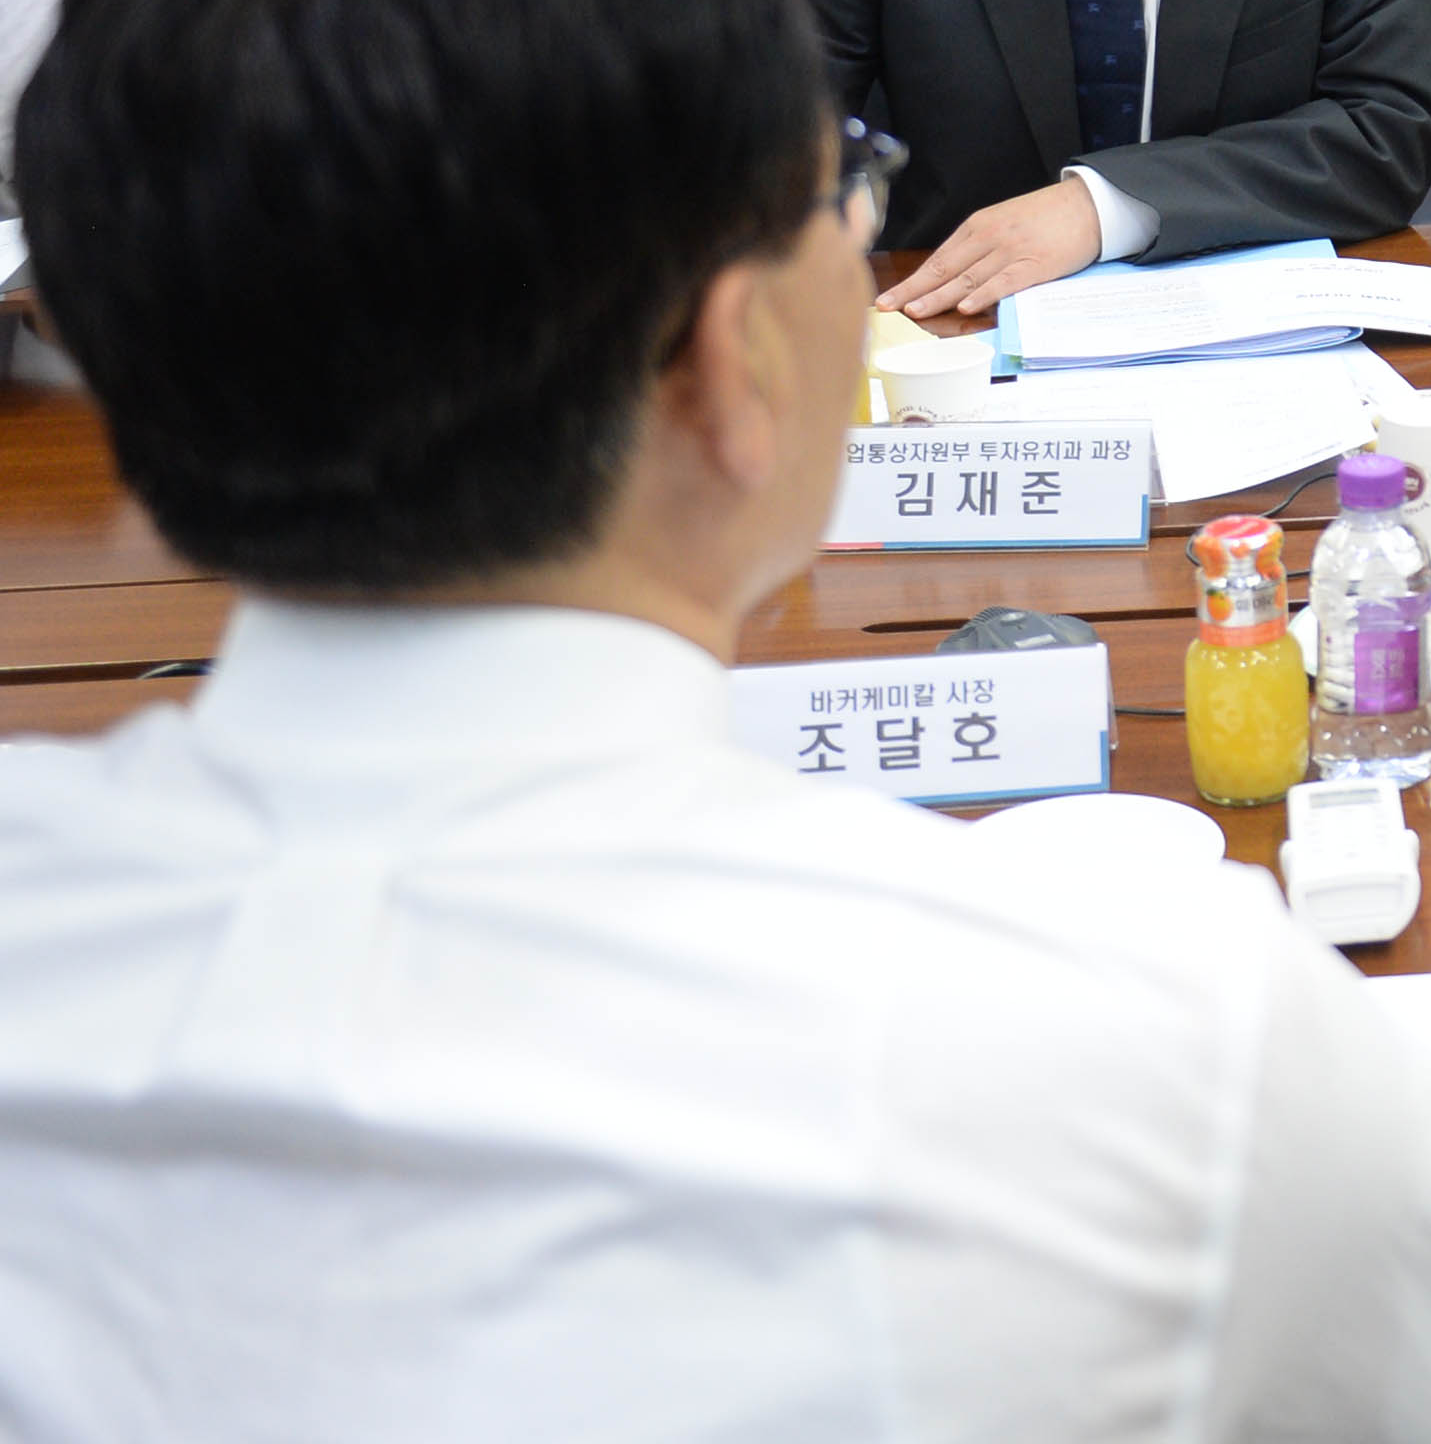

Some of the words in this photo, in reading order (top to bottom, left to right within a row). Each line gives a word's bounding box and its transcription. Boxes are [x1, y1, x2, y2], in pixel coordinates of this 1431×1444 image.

[979, 440, 1083, 463] 투자유치과
[1091, 439, 1132, 461] 과장
[810, 683, 936, 714] 바커케미칼
[946, 679, 996, 705] 사장
